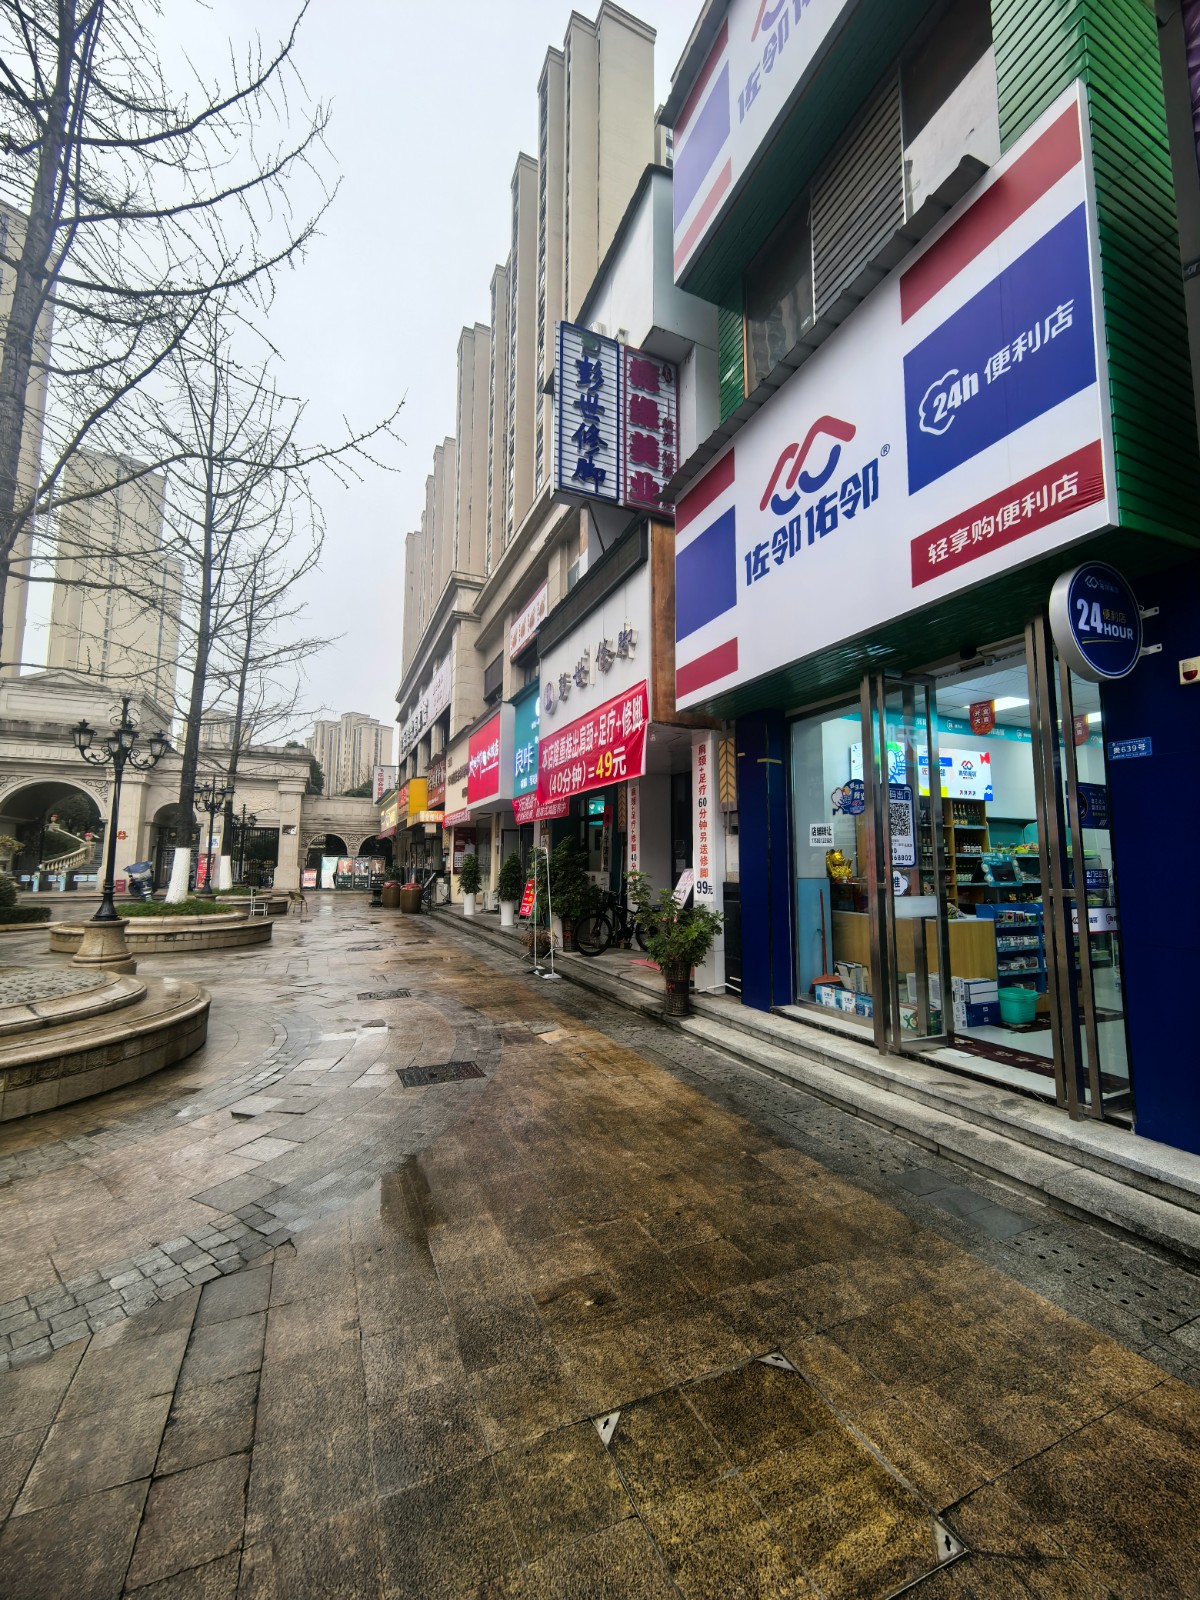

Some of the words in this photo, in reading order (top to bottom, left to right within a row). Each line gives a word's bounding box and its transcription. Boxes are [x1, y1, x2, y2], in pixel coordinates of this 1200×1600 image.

[738, 0, 810, 124] 佐邻
[985, 298, 1074, 383] 便利店
[744, 455, 880, 586] 佐邻佑邻
[927, 470, 1079, 566] 轻享购便利店
[1077, 598, 1103, 634] 24
[1103, 622, 1134, 640] HOUR
[696, 880, 714, 895] 99元
